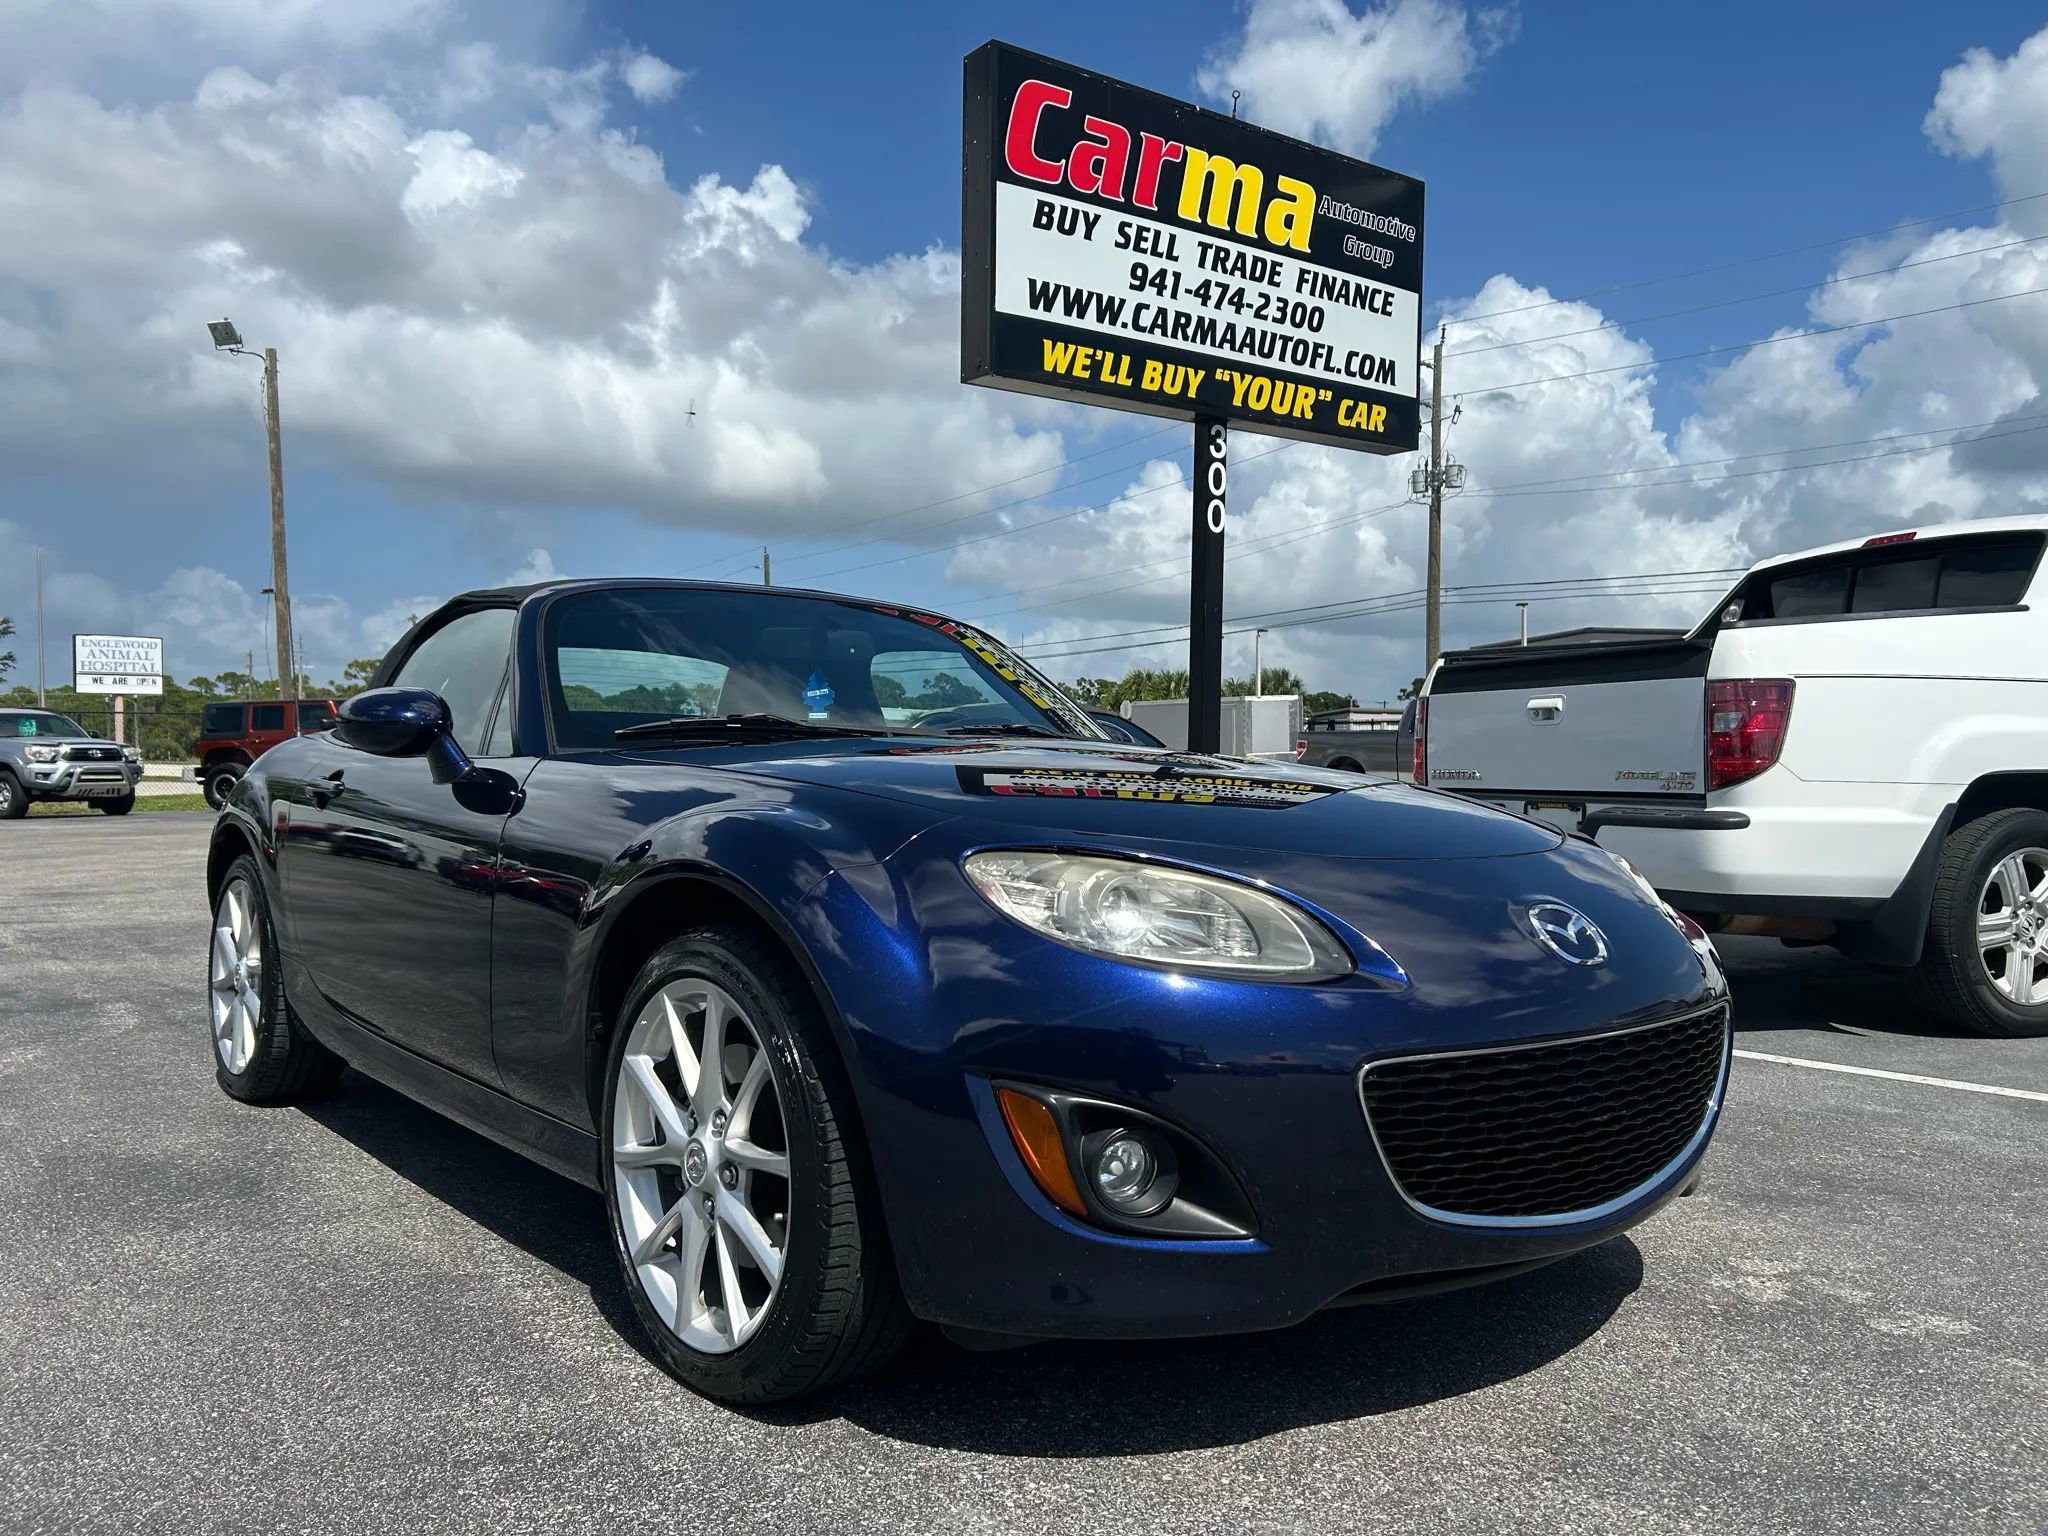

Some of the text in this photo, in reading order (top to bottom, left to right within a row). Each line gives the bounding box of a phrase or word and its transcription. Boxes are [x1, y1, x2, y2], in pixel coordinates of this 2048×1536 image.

[1004, 79, 1317, 253] Carma
[1318, 195, 1416, 242] Automotive
[1032, 198, 1395, 317] BUY SELL TRADE FINANCE
[1343, 234, 1395, 268] Group
[1129, 262, 1325, 333] 941-474-2300
[1027, 277, 1397, 386] WWW.CARMAAUTOFL.COM
[1042, 338, 1132, 387] WE'LL
[1142, 359, 1205, 399] BUY
[1337, 399, 1387, 433] CAR
[1207, 424, 1227, 533] 300
[80, 638, 158, 650] ENGLEWOOD
[86, 649, 154, 661] ANIMAL
[80, 660, 160, 672] HOSPITAL
[92, 676, 104, 684] WE
[112, 677, 128, 685] ARE
[1431, 769, 1482, 780] HONDA
[1615, 770, 1696, 781] RIDGELINE
[1660, 780, 1695, 791] 4WD
